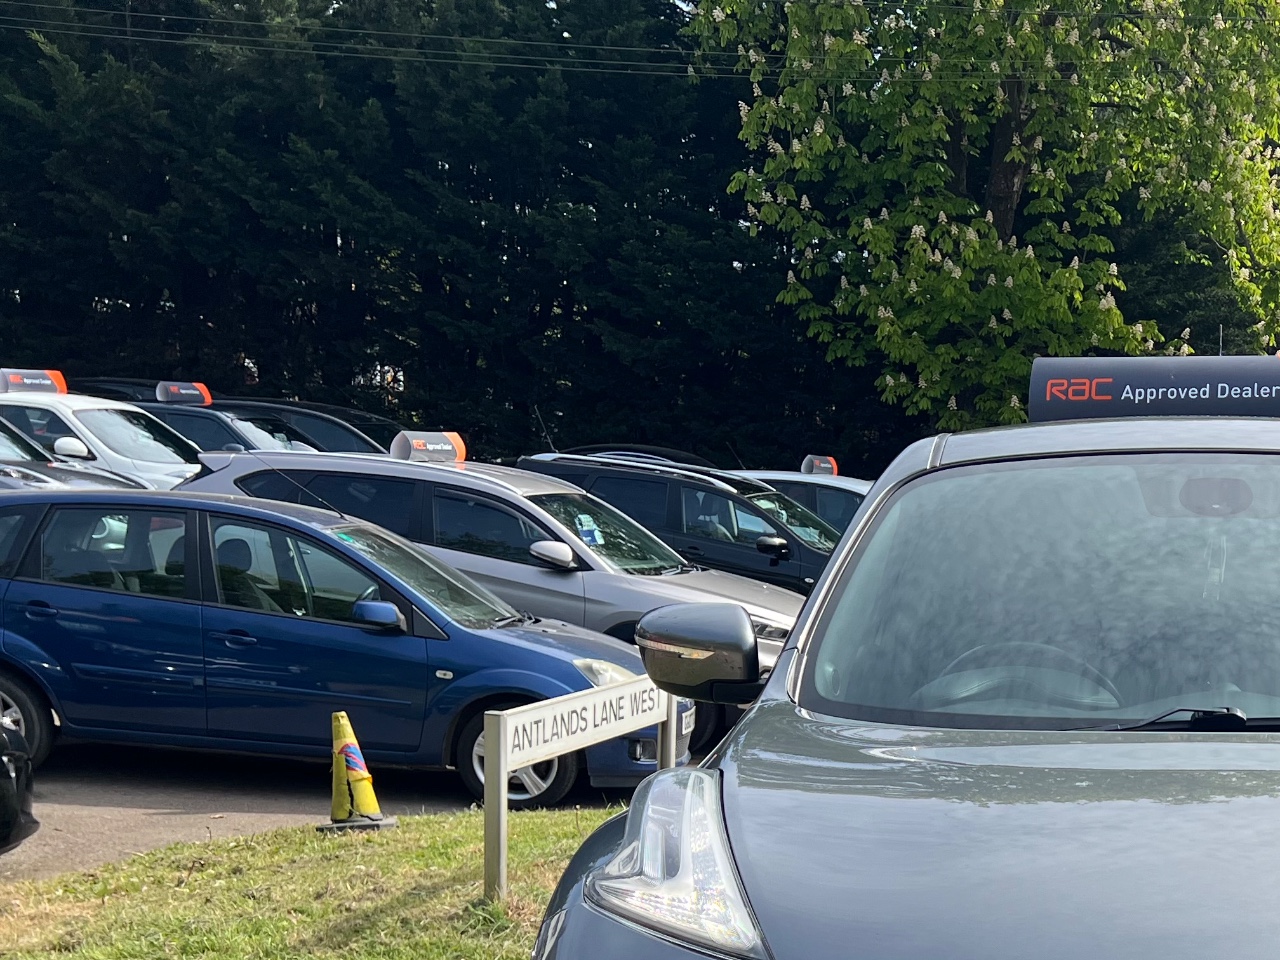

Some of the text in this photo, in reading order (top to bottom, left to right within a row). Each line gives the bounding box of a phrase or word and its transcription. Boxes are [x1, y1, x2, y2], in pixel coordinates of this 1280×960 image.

[1121, 383, 1210, 403] Approved
[1217, 383, 1280, 399] Dealer
[511, 687, 661, 754] ANTLANDS LANE WEST
